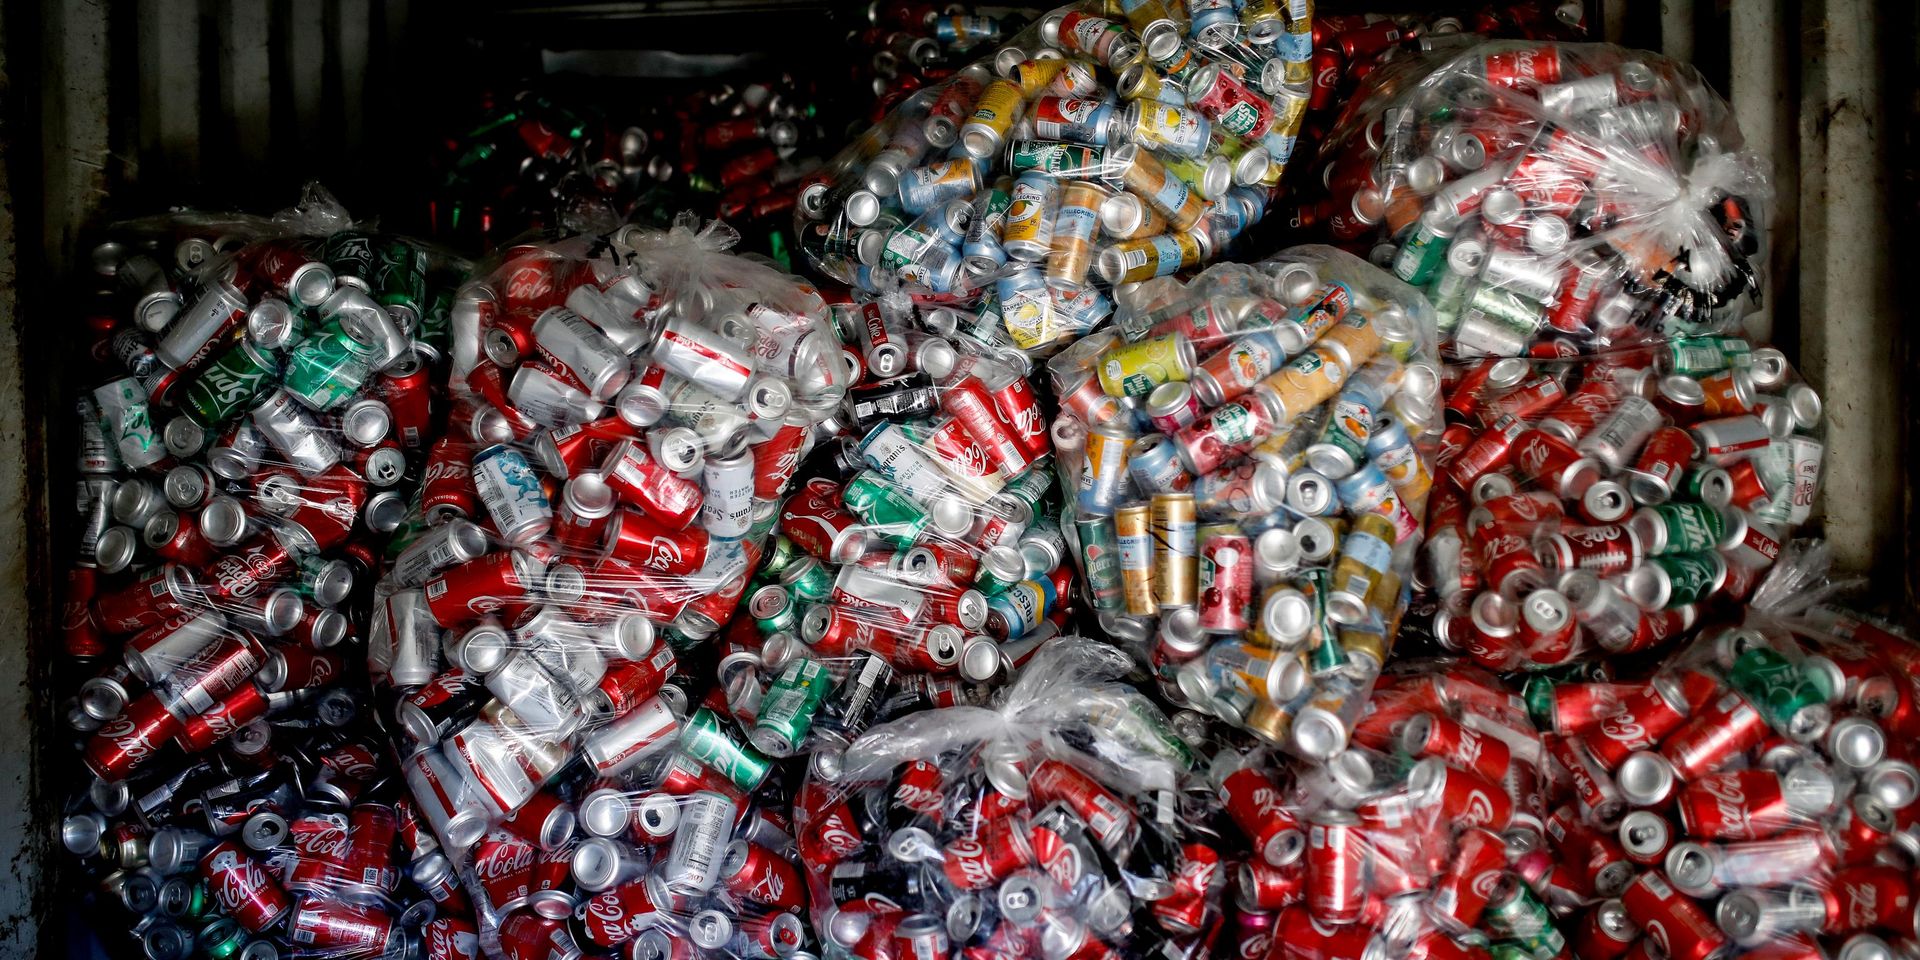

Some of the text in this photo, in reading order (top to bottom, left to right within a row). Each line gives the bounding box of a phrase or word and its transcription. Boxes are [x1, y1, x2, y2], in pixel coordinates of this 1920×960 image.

[867, 318, 880, 340] Coke
[186, 338, 221, 369] Coke
[203, 366, 251, 403] Spri
[1758, 537, 1779, 558] Coke
[841, 594, 869, 608] oke
[1012, 586, 1031, 624] FRESC
[490, 867, 531, 885] ORIGINAL TASTE
